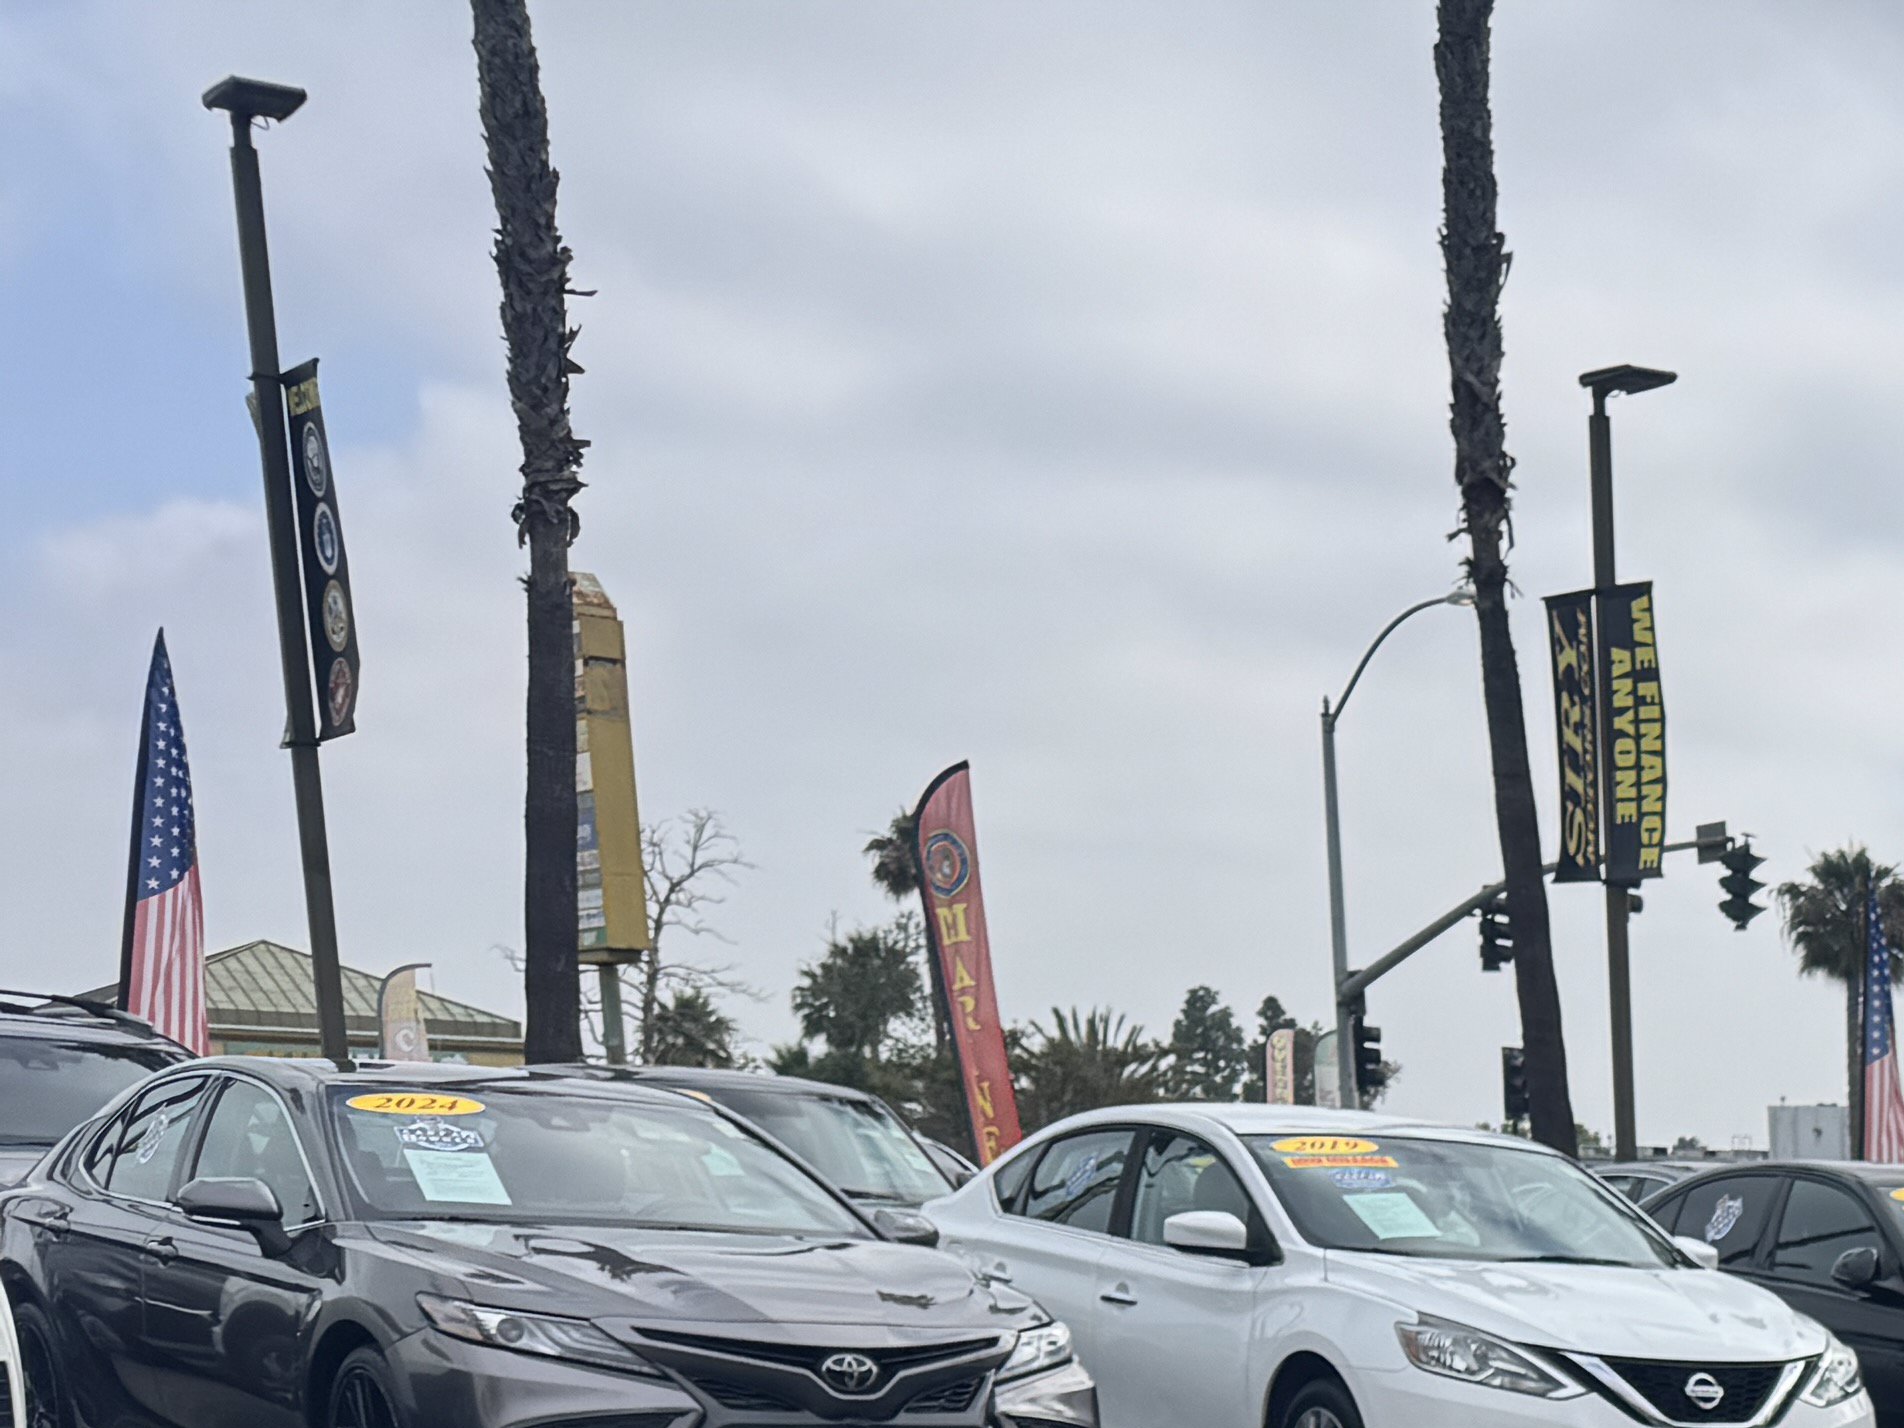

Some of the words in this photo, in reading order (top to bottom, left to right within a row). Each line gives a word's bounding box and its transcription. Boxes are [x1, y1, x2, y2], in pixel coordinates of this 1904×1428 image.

[1631, 594, 1656, 670] WE
[1552, 607, 1585, 869] SIRY
[1610, 647, 1638, 825] ANYONE
[1637, 680, 1662, 870] FINANCE
[375, 1097, 459, 1111] 2024
[1294, 1140, 1359, 1151] 2019
